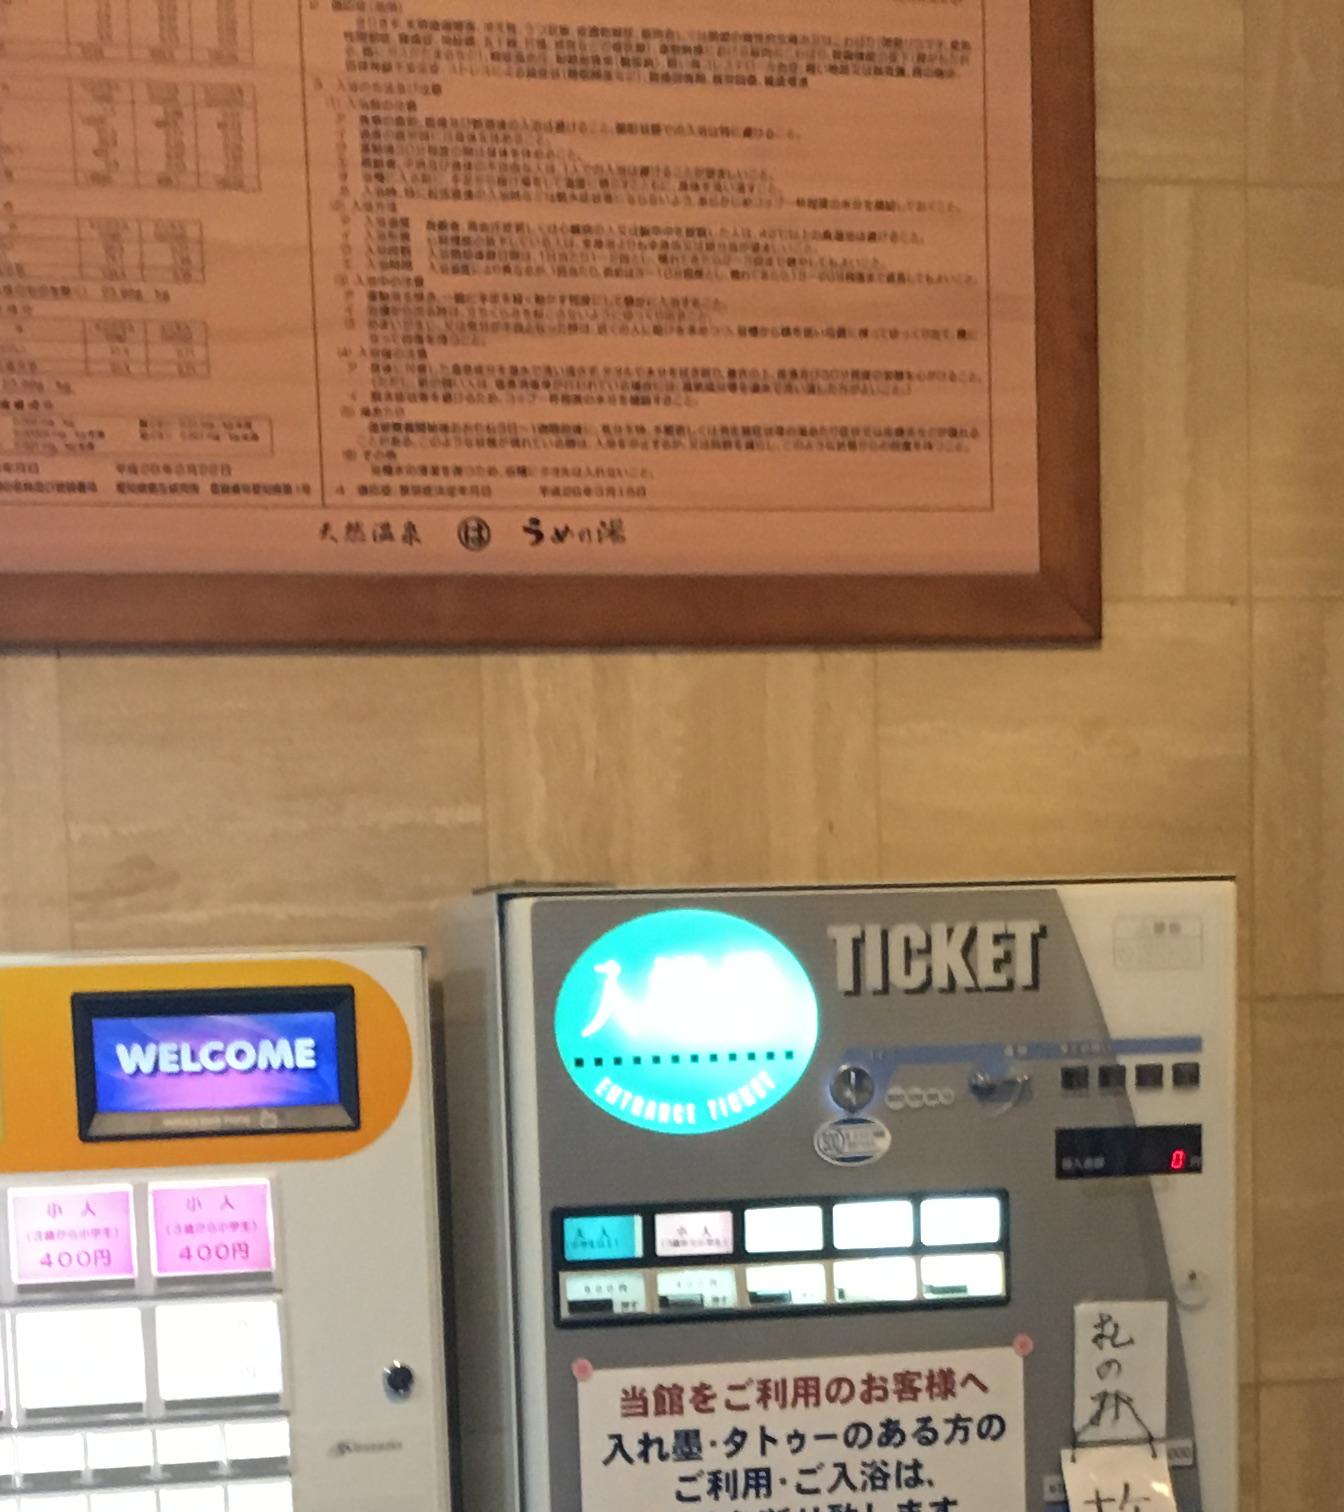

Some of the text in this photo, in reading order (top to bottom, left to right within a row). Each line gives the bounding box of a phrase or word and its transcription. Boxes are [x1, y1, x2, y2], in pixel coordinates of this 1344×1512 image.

[320, 520, 422, 546] 天然温泉
[828, 919, 1048, 996] TICKET
[115, 1036, 318, 1075] WELCOME
[593, 1075, 698, 1126] ENTRANCE
[1171, 1149, 1187, 1170] 0
[46, 1200, 97, 1219] 小人
[186, 1194, 236, 1213] 小人
[39, 1249, 113, 1268] 400円
[179, 1240, 250, 1262] 400円
[619, 1366, 989, 1419] 当館をご利用のお客様へ
[602, 1413, 1007, 1466] 入れ墨・タトゥーのある方の
